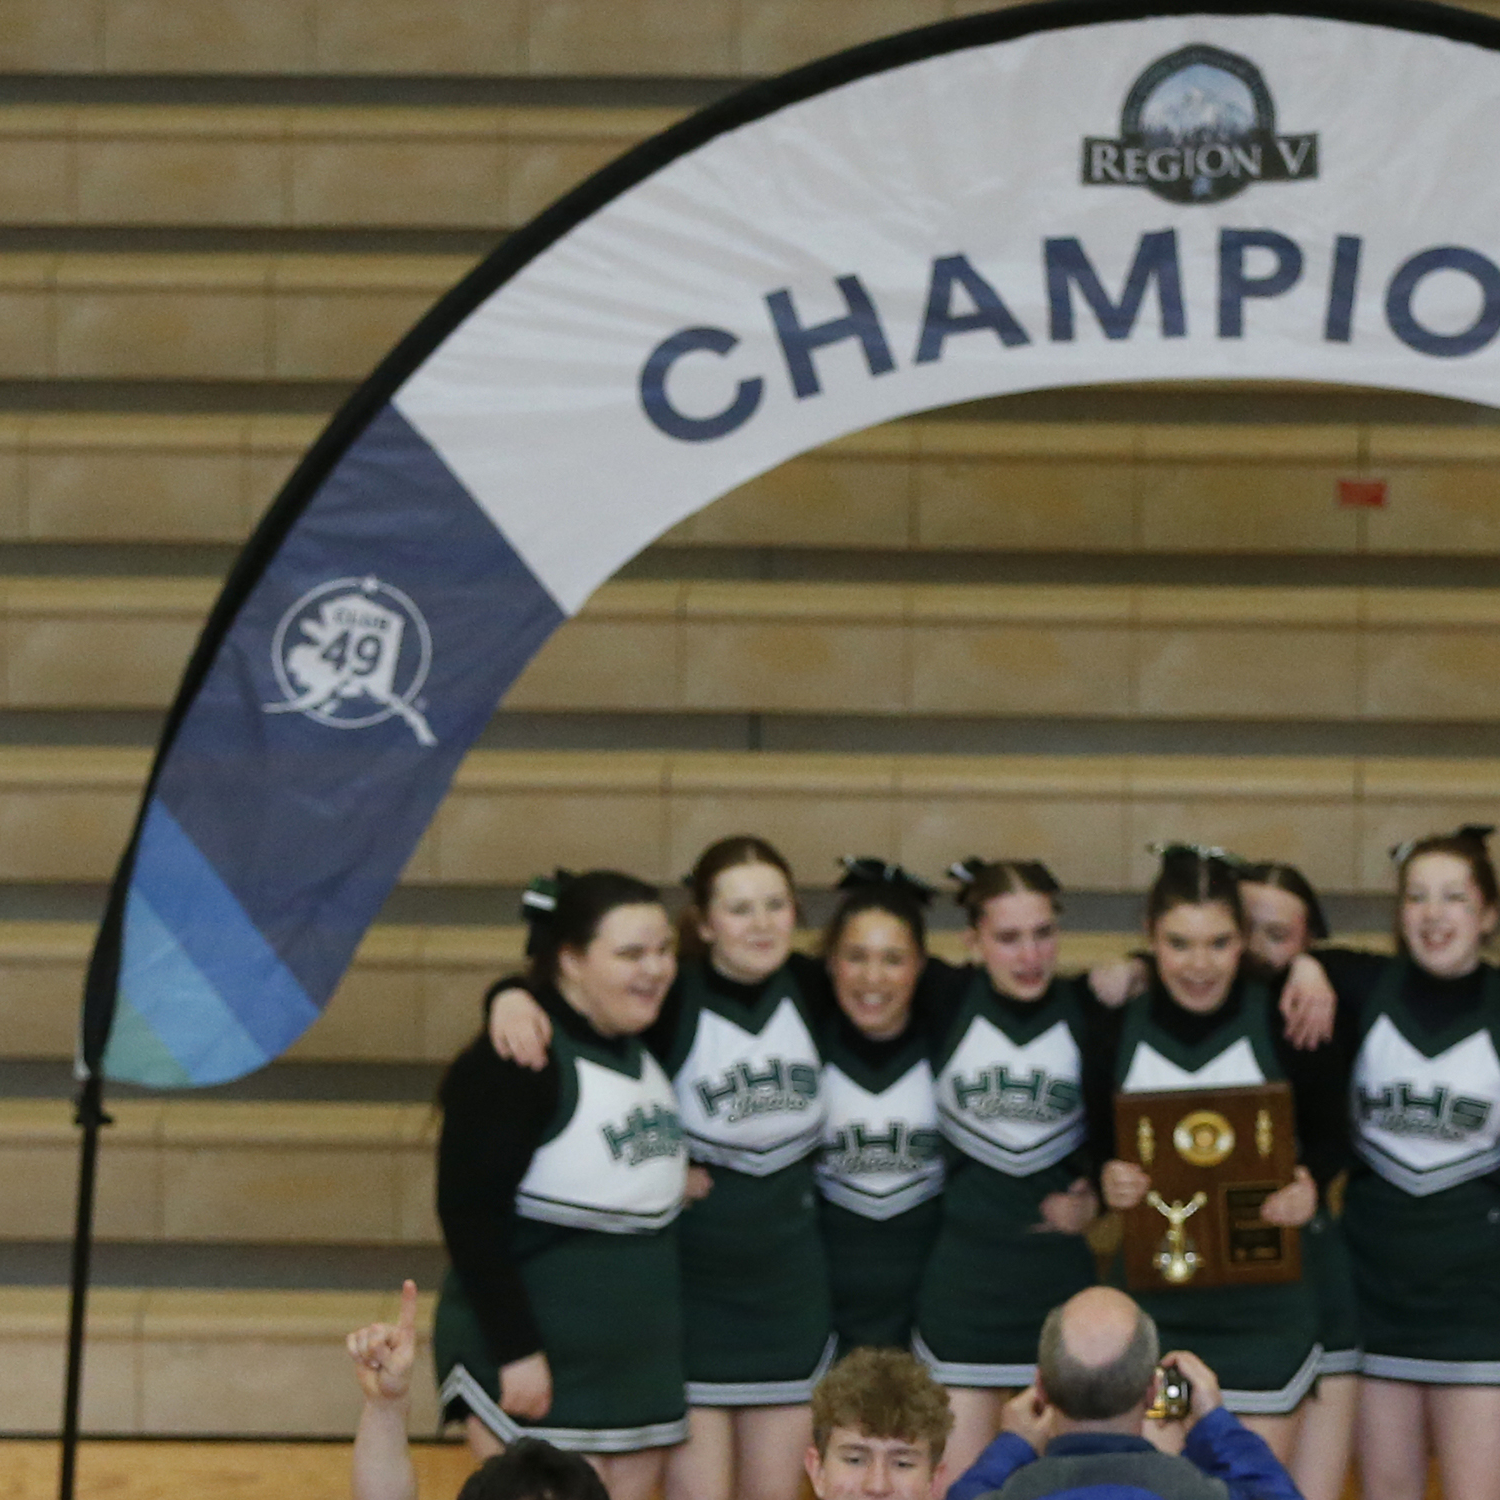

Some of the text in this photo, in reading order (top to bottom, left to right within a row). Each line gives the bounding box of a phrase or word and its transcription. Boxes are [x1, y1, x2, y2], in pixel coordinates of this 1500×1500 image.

[1090, 138, 1311, 182] REGION V
[321, 629, 381, 676] 49
[695, 1057, 820, 1118] HHS
[1357, 1082, 1492, 1129] HHS
